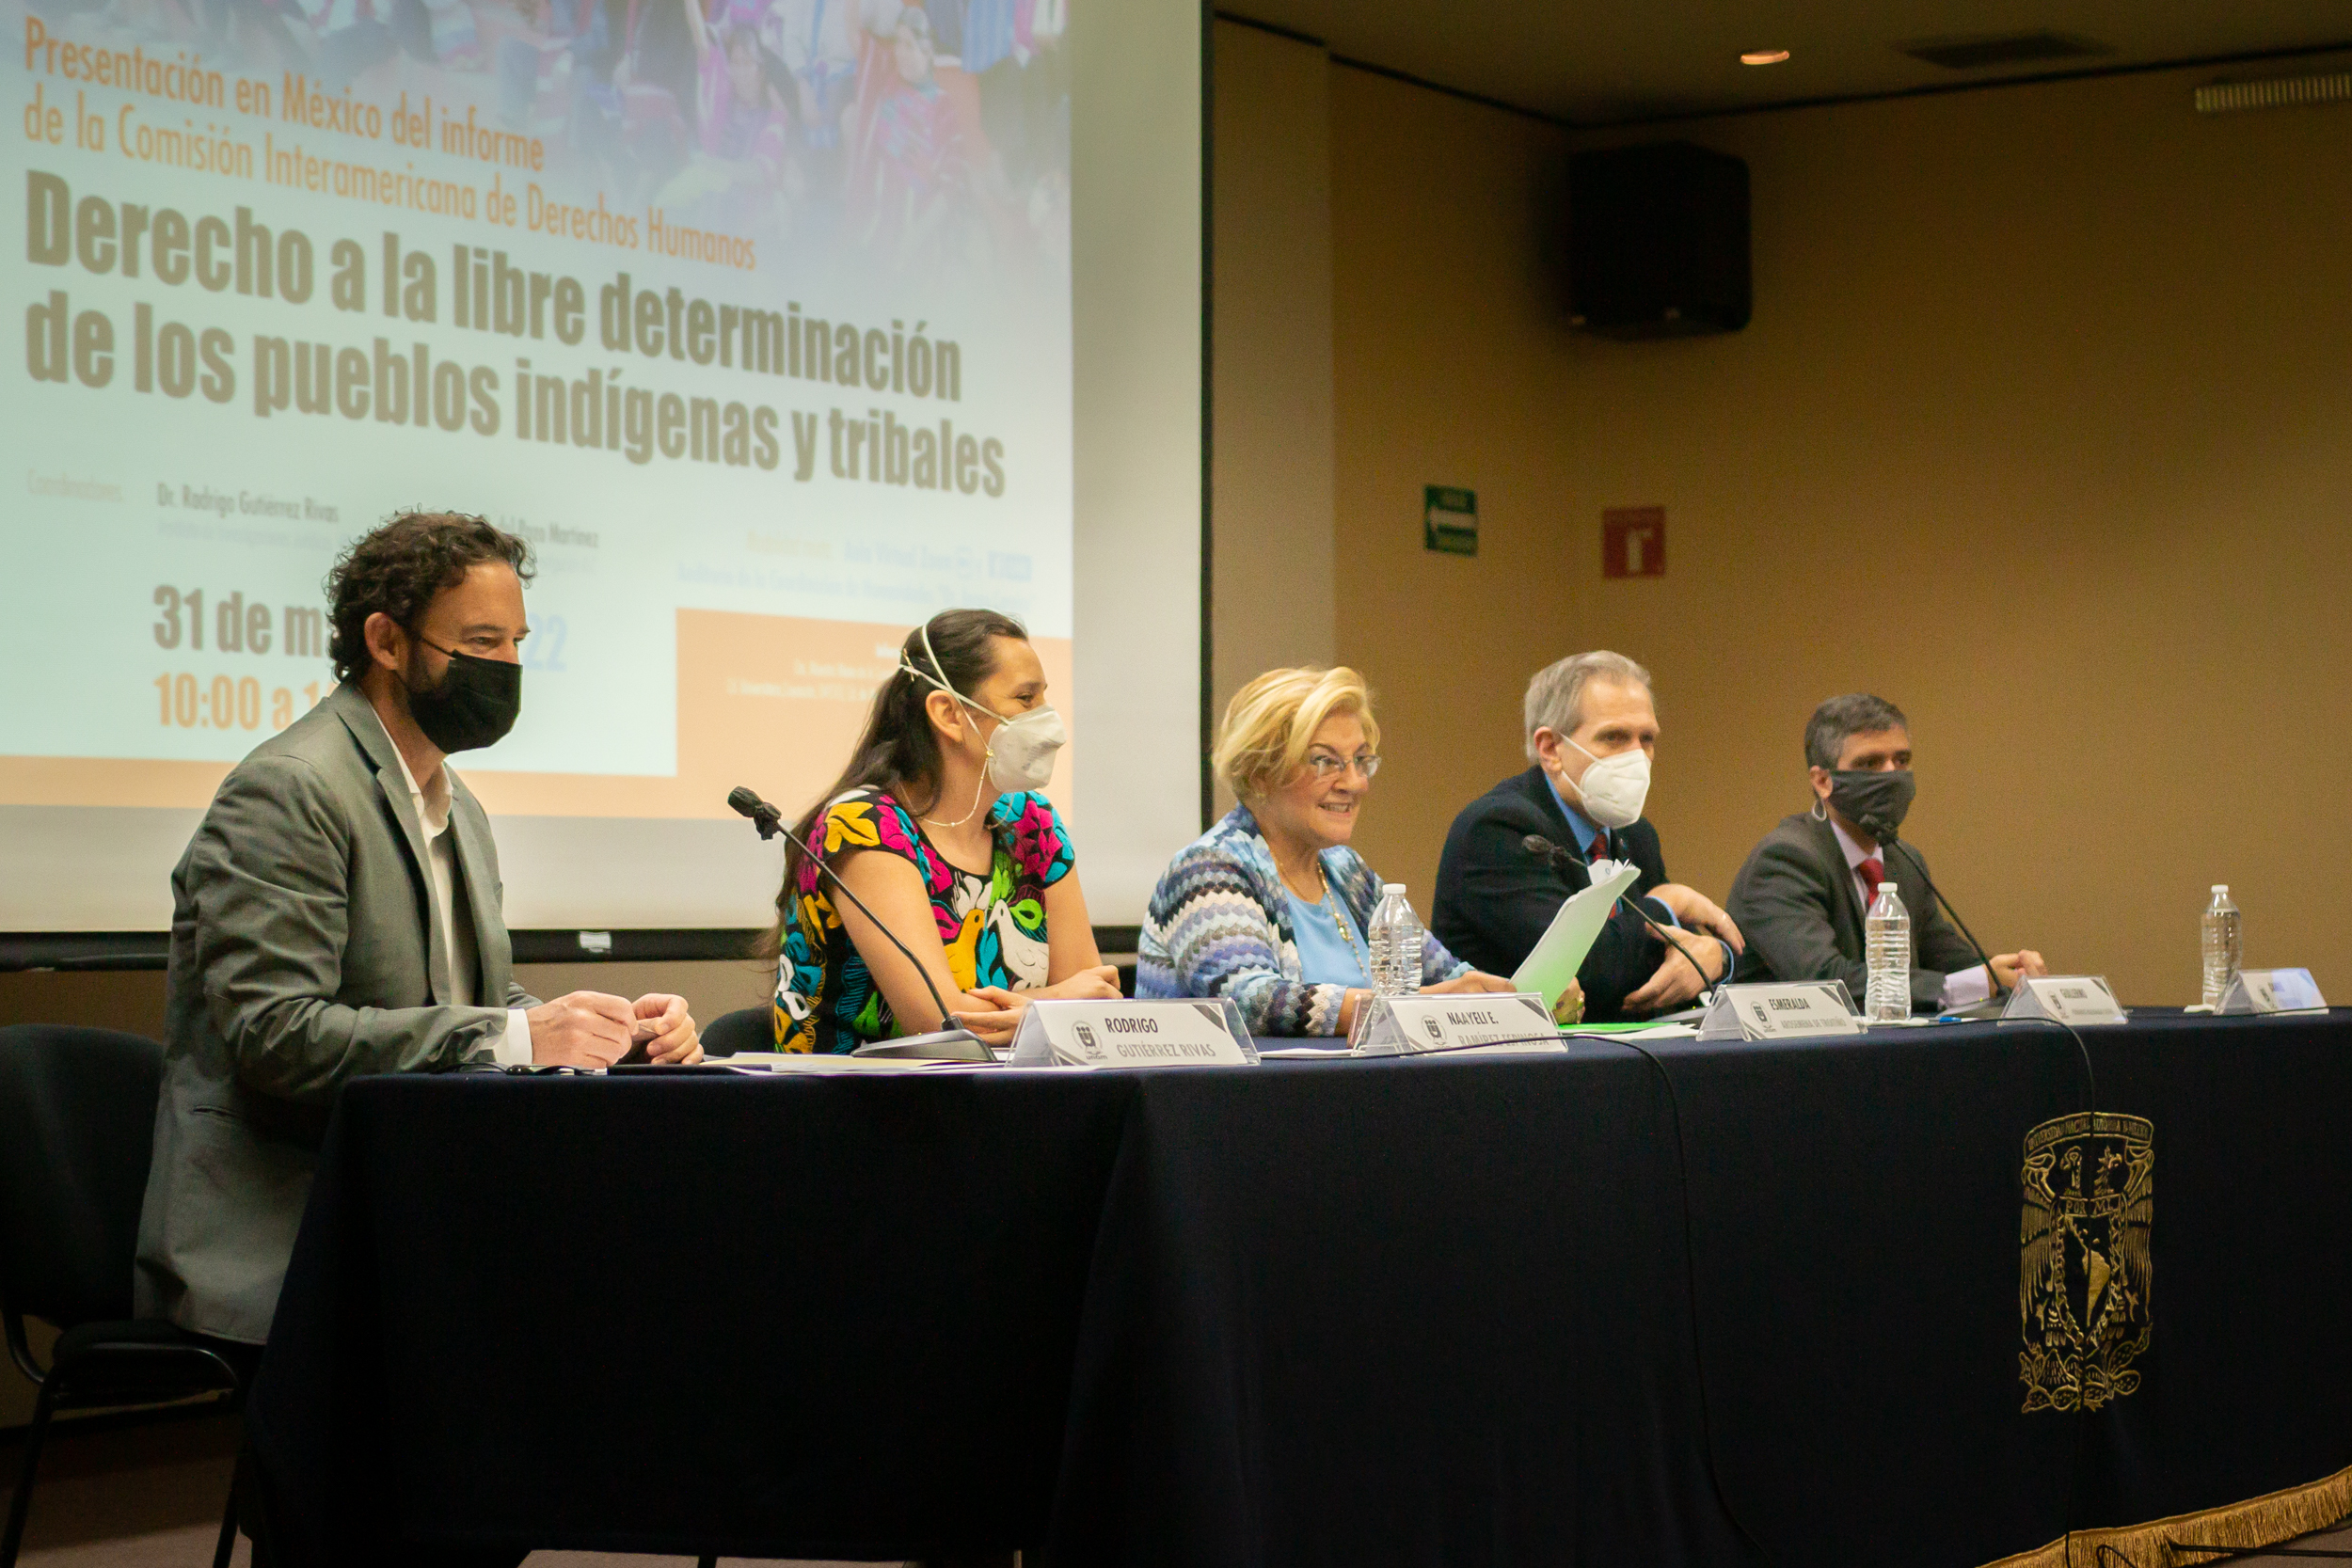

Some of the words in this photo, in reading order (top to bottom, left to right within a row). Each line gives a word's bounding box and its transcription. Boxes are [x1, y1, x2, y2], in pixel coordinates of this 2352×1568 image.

[25, 15, 225, 109] Presentación
[236, 77, 271, 119] en
[282, 71, 381, 139] México
[392, 90, 432, 150] del
[442, 105, 544, 172] informe
[24, 82, 64, 144] de
[77, 89, 104, 152] la
[118, 103, 253, 181] Comisión
[265, 134, 477, 221] Interamericana
[486, 173, 516, 228] de
[528, 182, 639, 249] Derechos
[647, 206, 756, 271] Humanos
[26, 168, 314, 305] Derecho
[331, 237, 367, 313] a
[383, 230, 437, 324] la
[454, 243, 586, 347] libre
[599, 272, 962, 403] determinación
[26, 289, 115, 390] de
[134, 301, 237, 404] los
[253, 334, 501, 437] pueblos
[516, 356, 780, 471] indígenas
[790, 408, 818, 483] y
[829, 407, 1005, 498] tribales
[153, 584, 203, 650] 31
[217, 591, 272, 655] de
[153, 672, 261, 731] 10:00
[272, 684, 294, 733] a
[1104, 1018, 1158, 1034] RODRIGO
[1447, 1011, 1488, 1025] NAAYELI
[1487, 1011, 1500, 1025] E.
[1769, 998, 1811, 1011] ESMERALDA
[1116, 1040, 1182, 1058] GUTIÉRREZ
[1182, 1043, 1216, 1057] RIVAS
